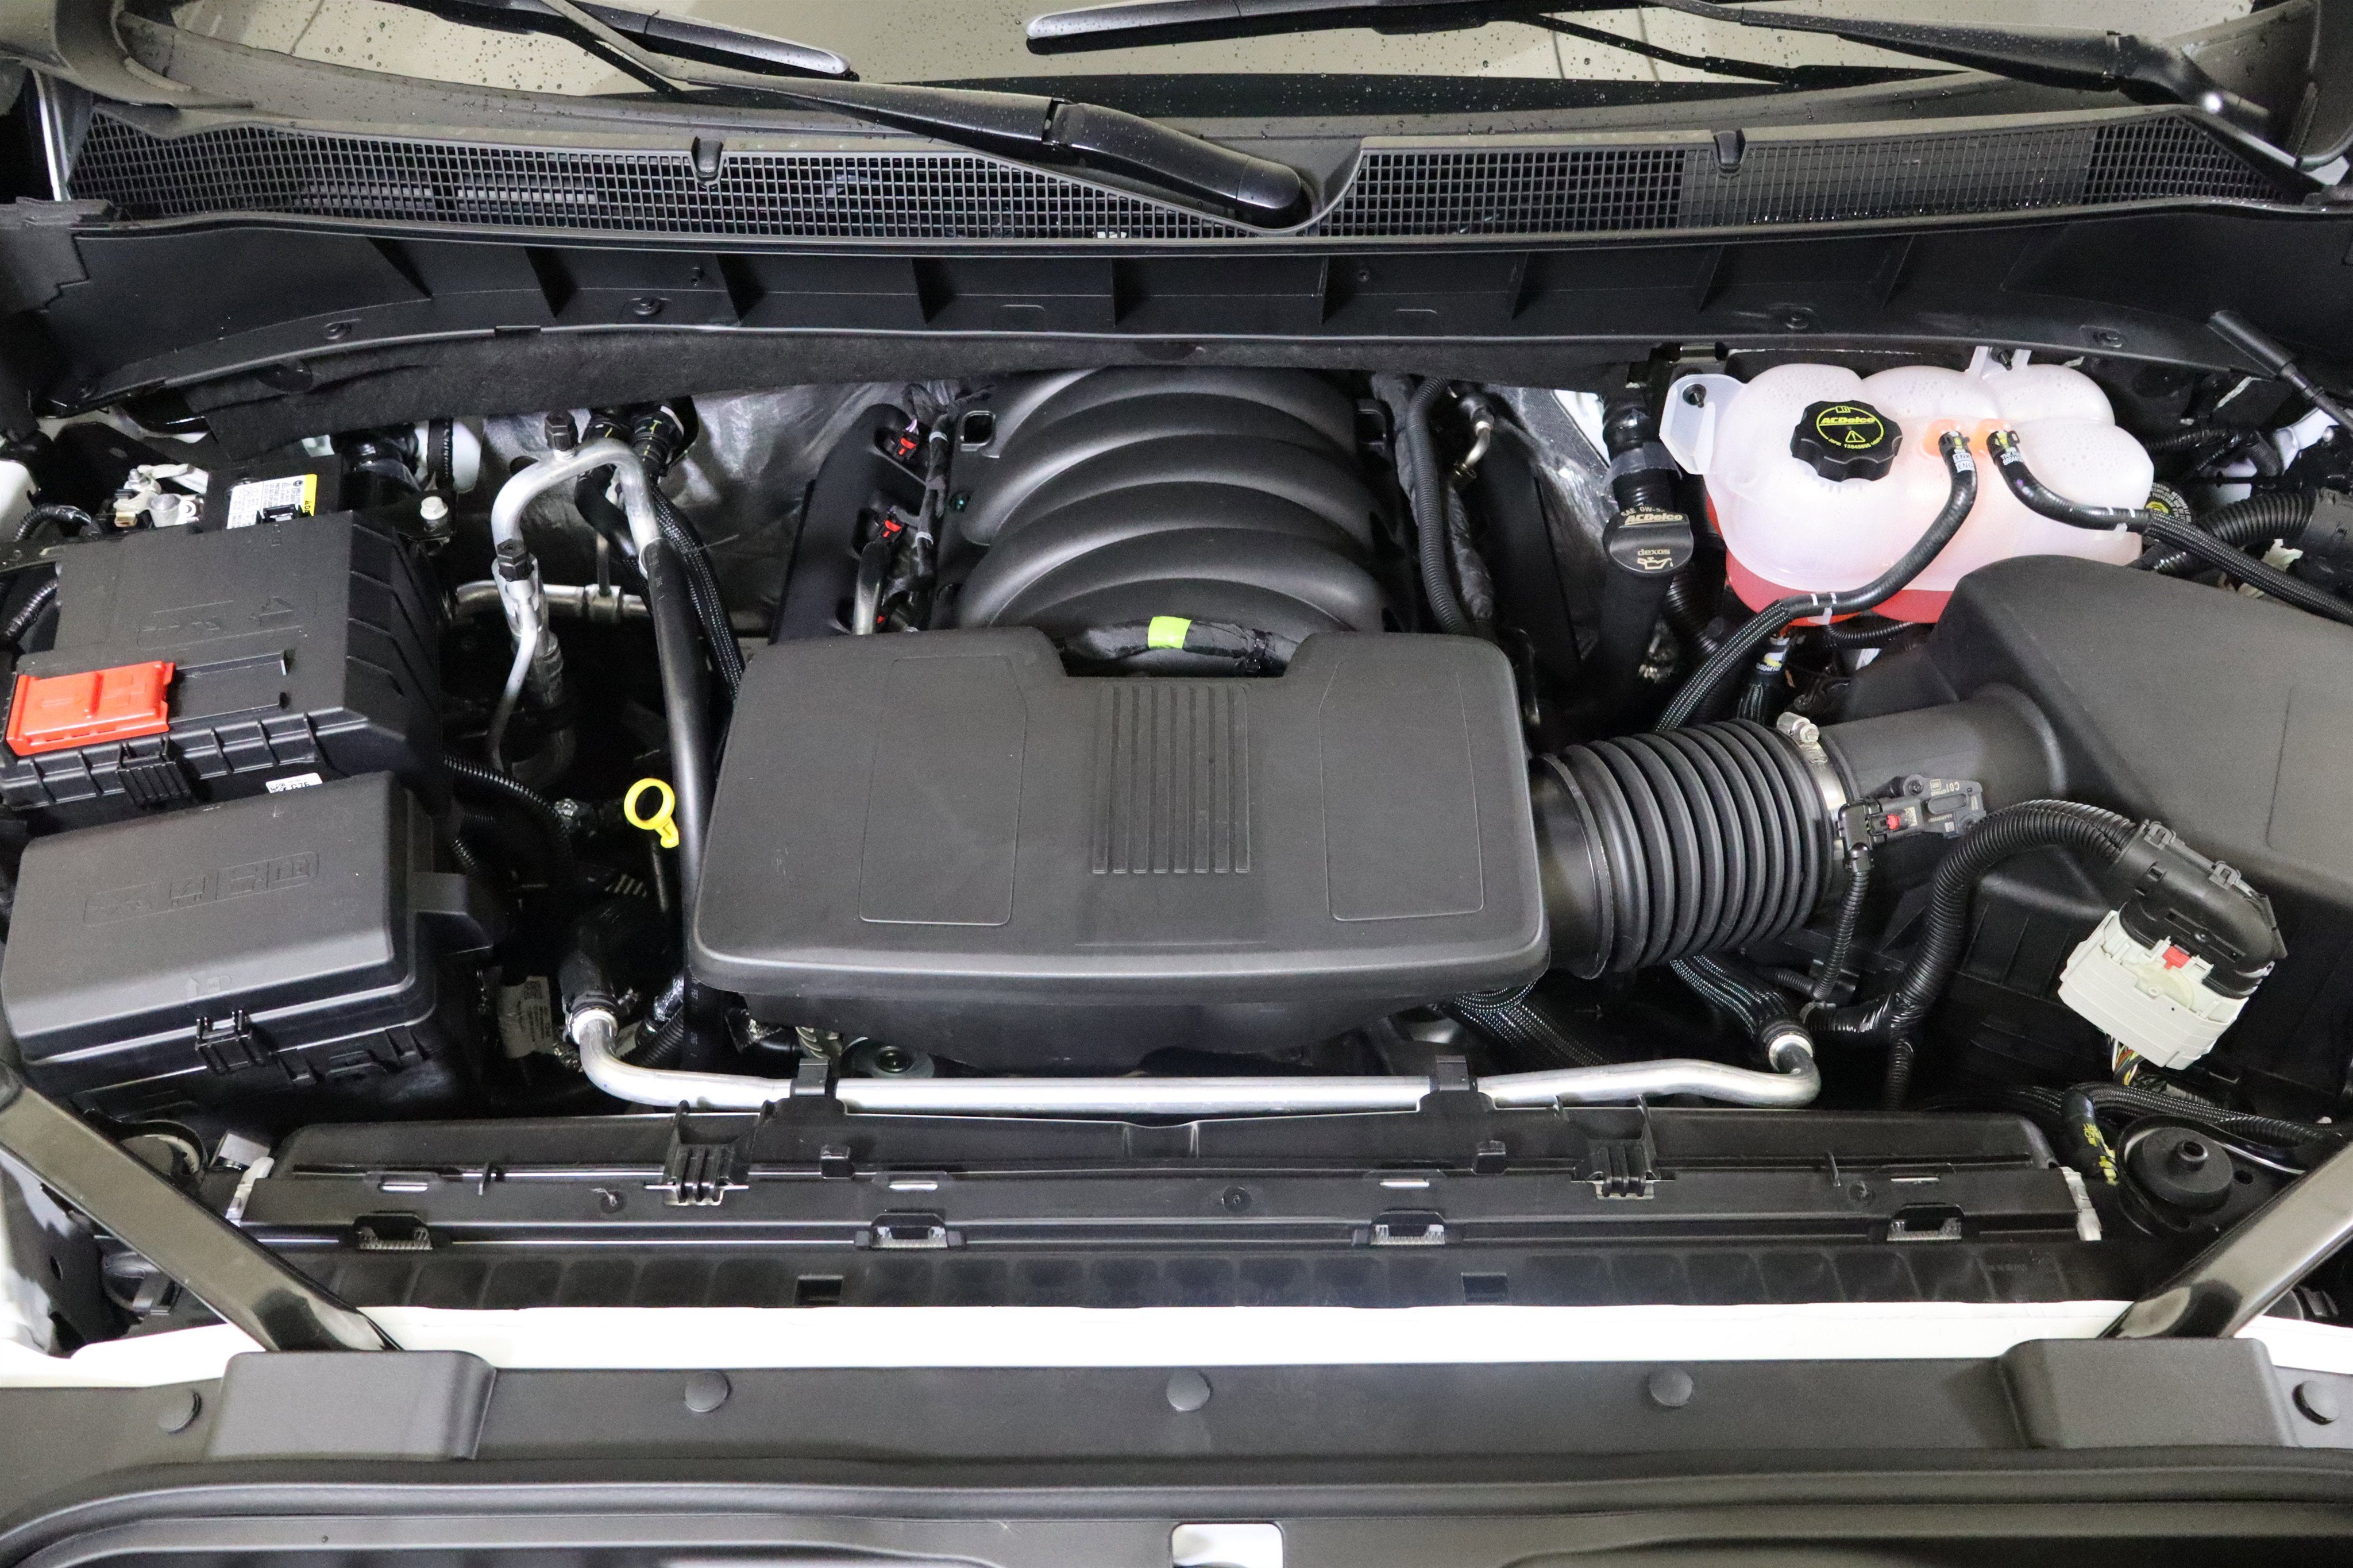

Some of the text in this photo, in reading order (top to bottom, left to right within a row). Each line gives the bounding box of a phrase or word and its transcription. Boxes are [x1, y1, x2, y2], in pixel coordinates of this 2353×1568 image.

[1820, 416, 1876, 425] ACDelco
[1621, 508, 1637, 517] SAE
[1625, 513, 1683, 524] ACDelco
[1946, 781, 1960, 793] C01
